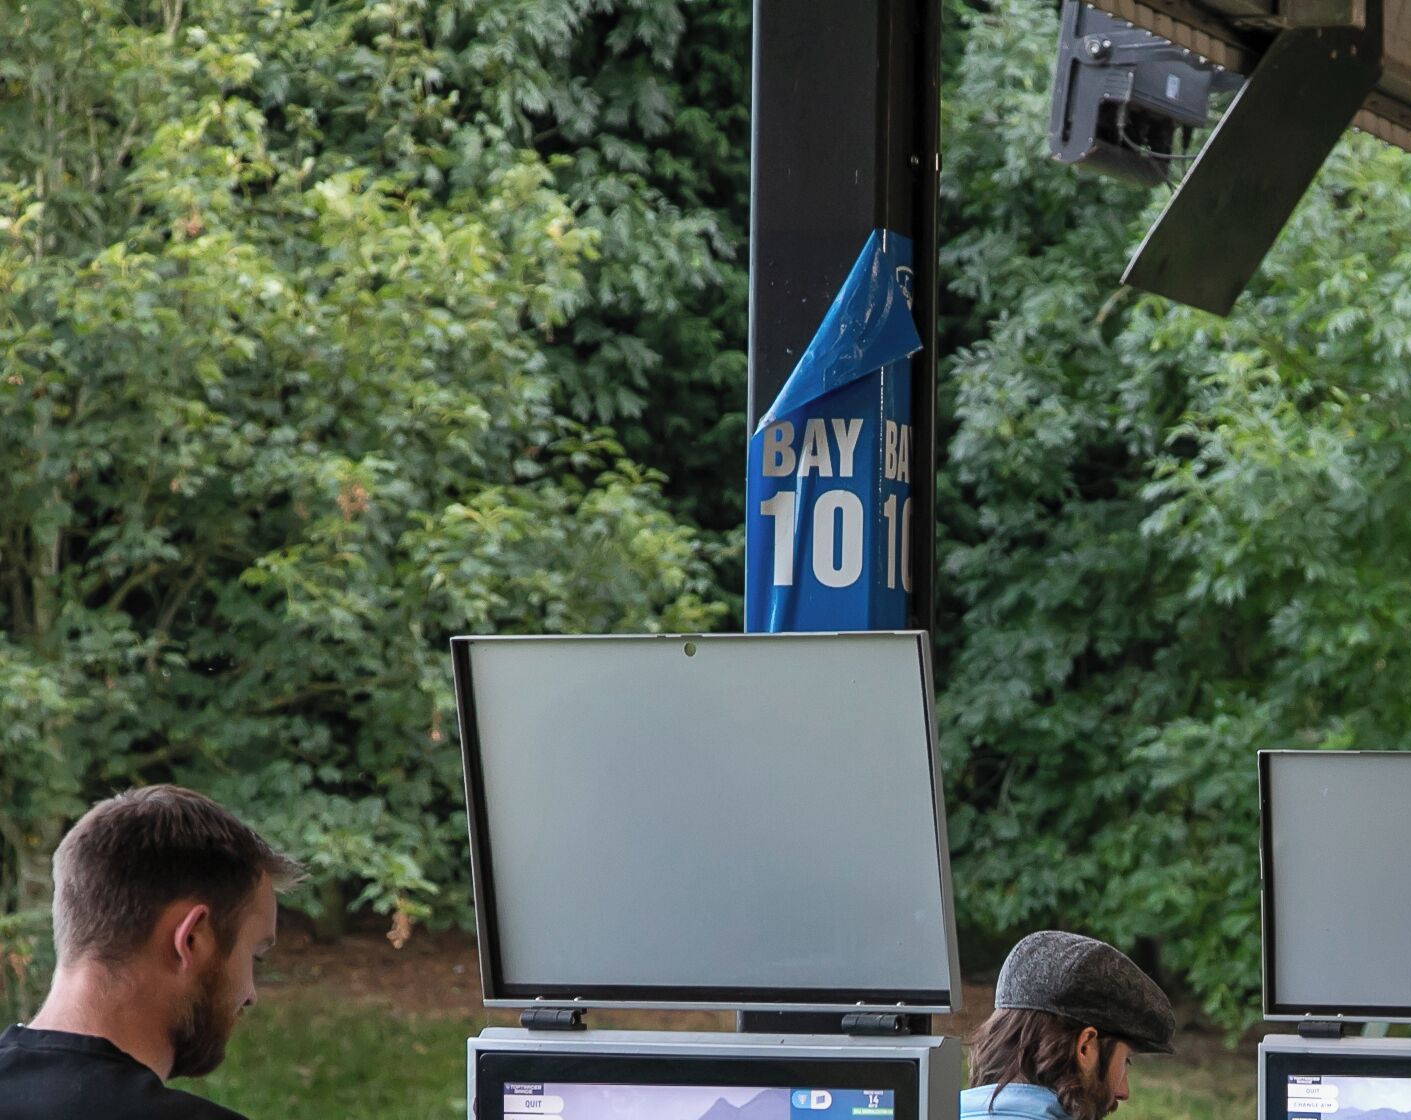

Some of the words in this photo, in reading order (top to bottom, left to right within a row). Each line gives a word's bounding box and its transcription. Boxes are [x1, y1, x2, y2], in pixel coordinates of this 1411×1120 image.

[762, 418, 864, 478] BAY
[884, 419, 913, 484] BA
[760, 489, 864, 588] 10
[525, 1100, 542, 1108] QUIT
